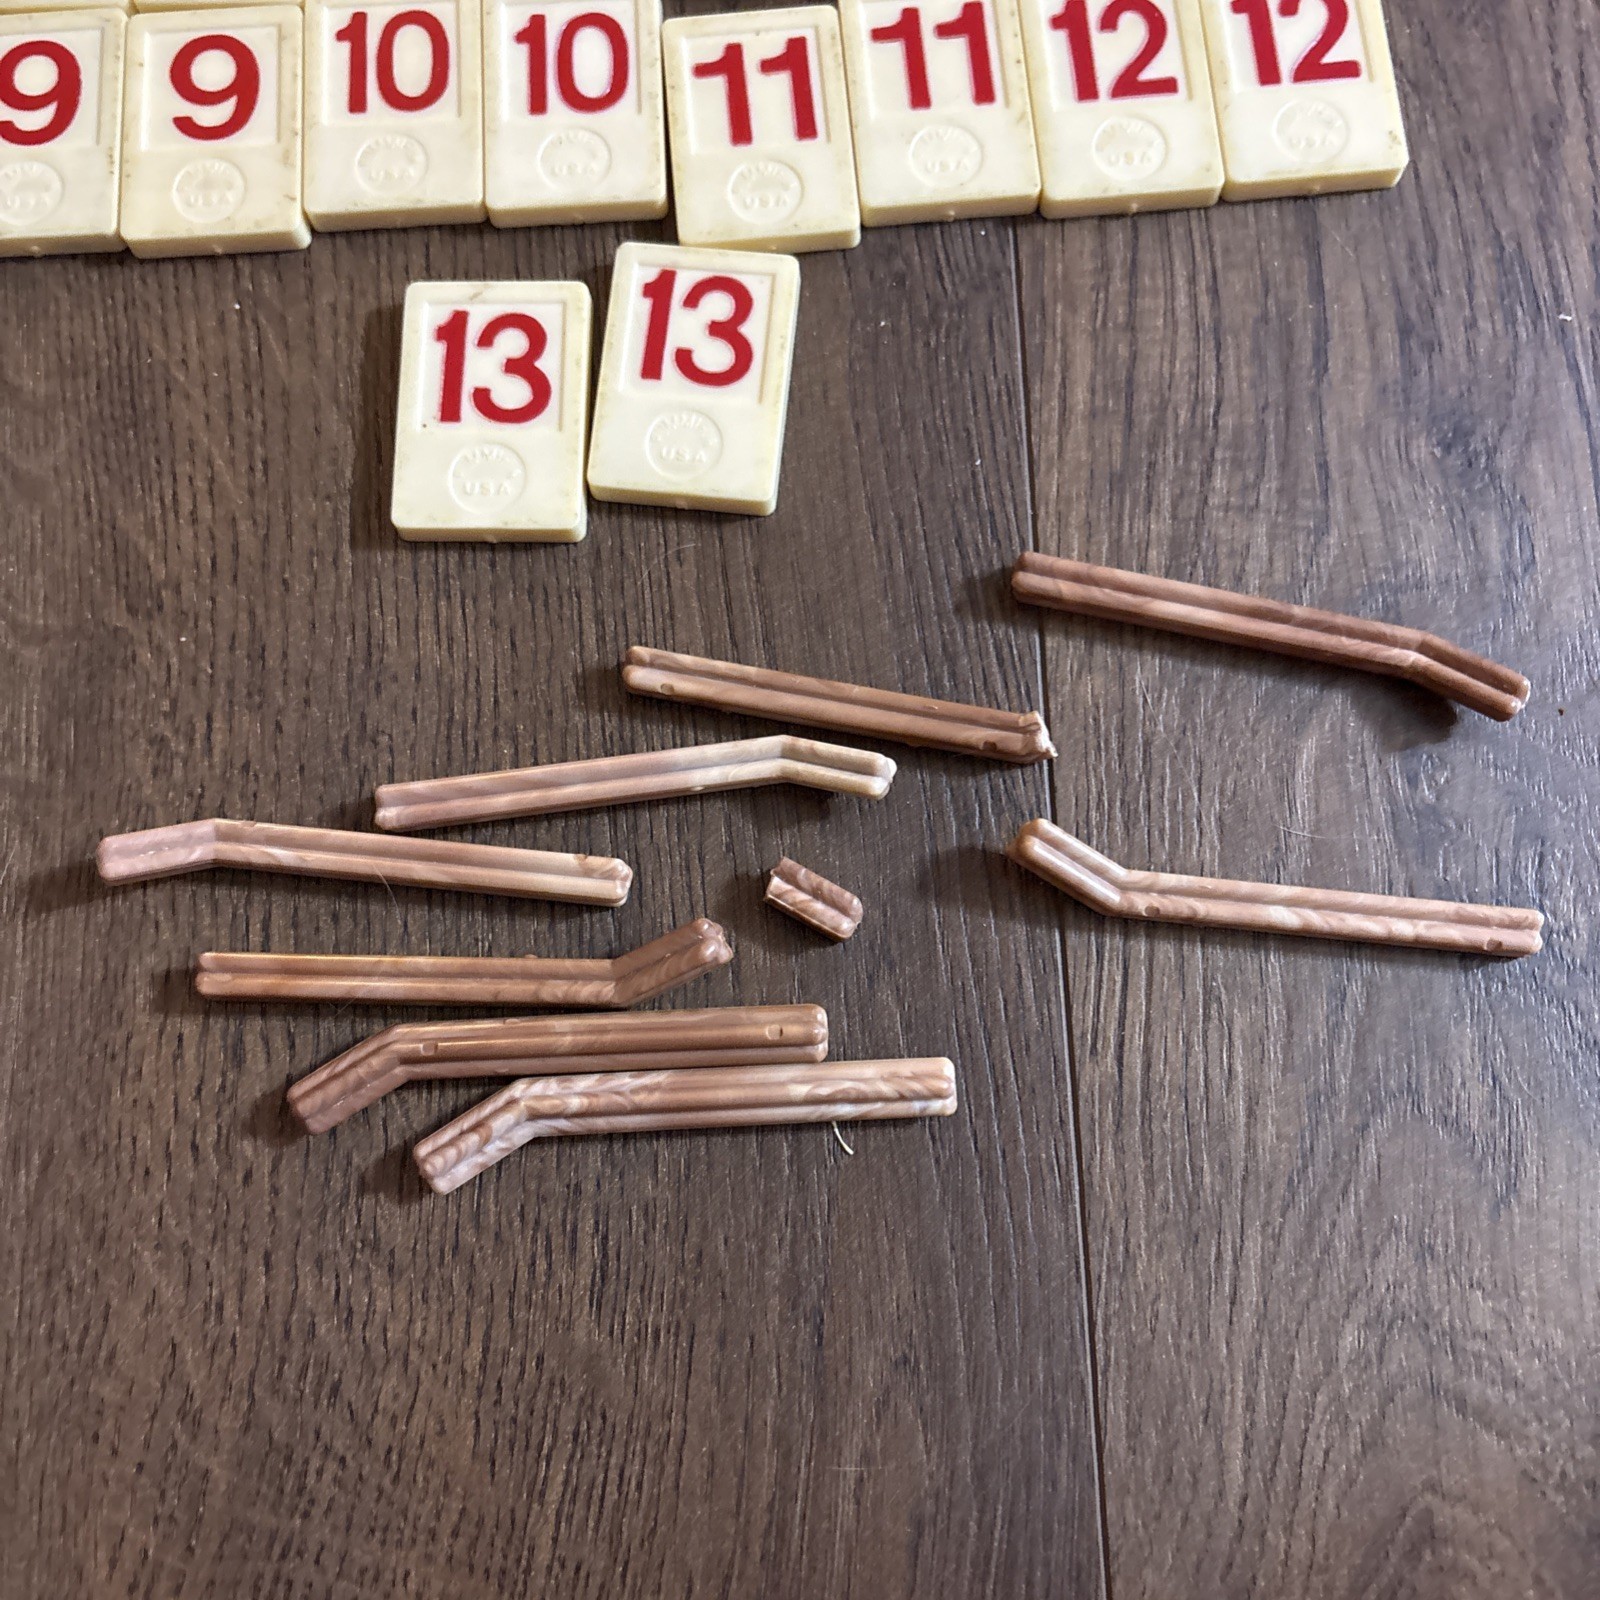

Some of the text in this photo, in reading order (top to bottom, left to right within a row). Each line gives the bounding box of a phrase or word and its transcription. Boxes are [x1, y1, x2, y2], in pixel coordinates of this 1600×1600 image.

[0, 41, 81, 146] 9
[169, 35, 259, 141] 9
[336, 10, 449, 113] 10
[514, 13, 628, 115] 10
[693, 37, 817, 145] 11
[871, 0, 995, 109] 11
[1050, 0, 1178, 101] 12
[1231, 0, 1361, 85] 12
[435, 310, 551, 424] 13
[641, 269, 753, 386] 13
[462, 480, 514, 497] USA
[660, 445, 708, 464] USA
